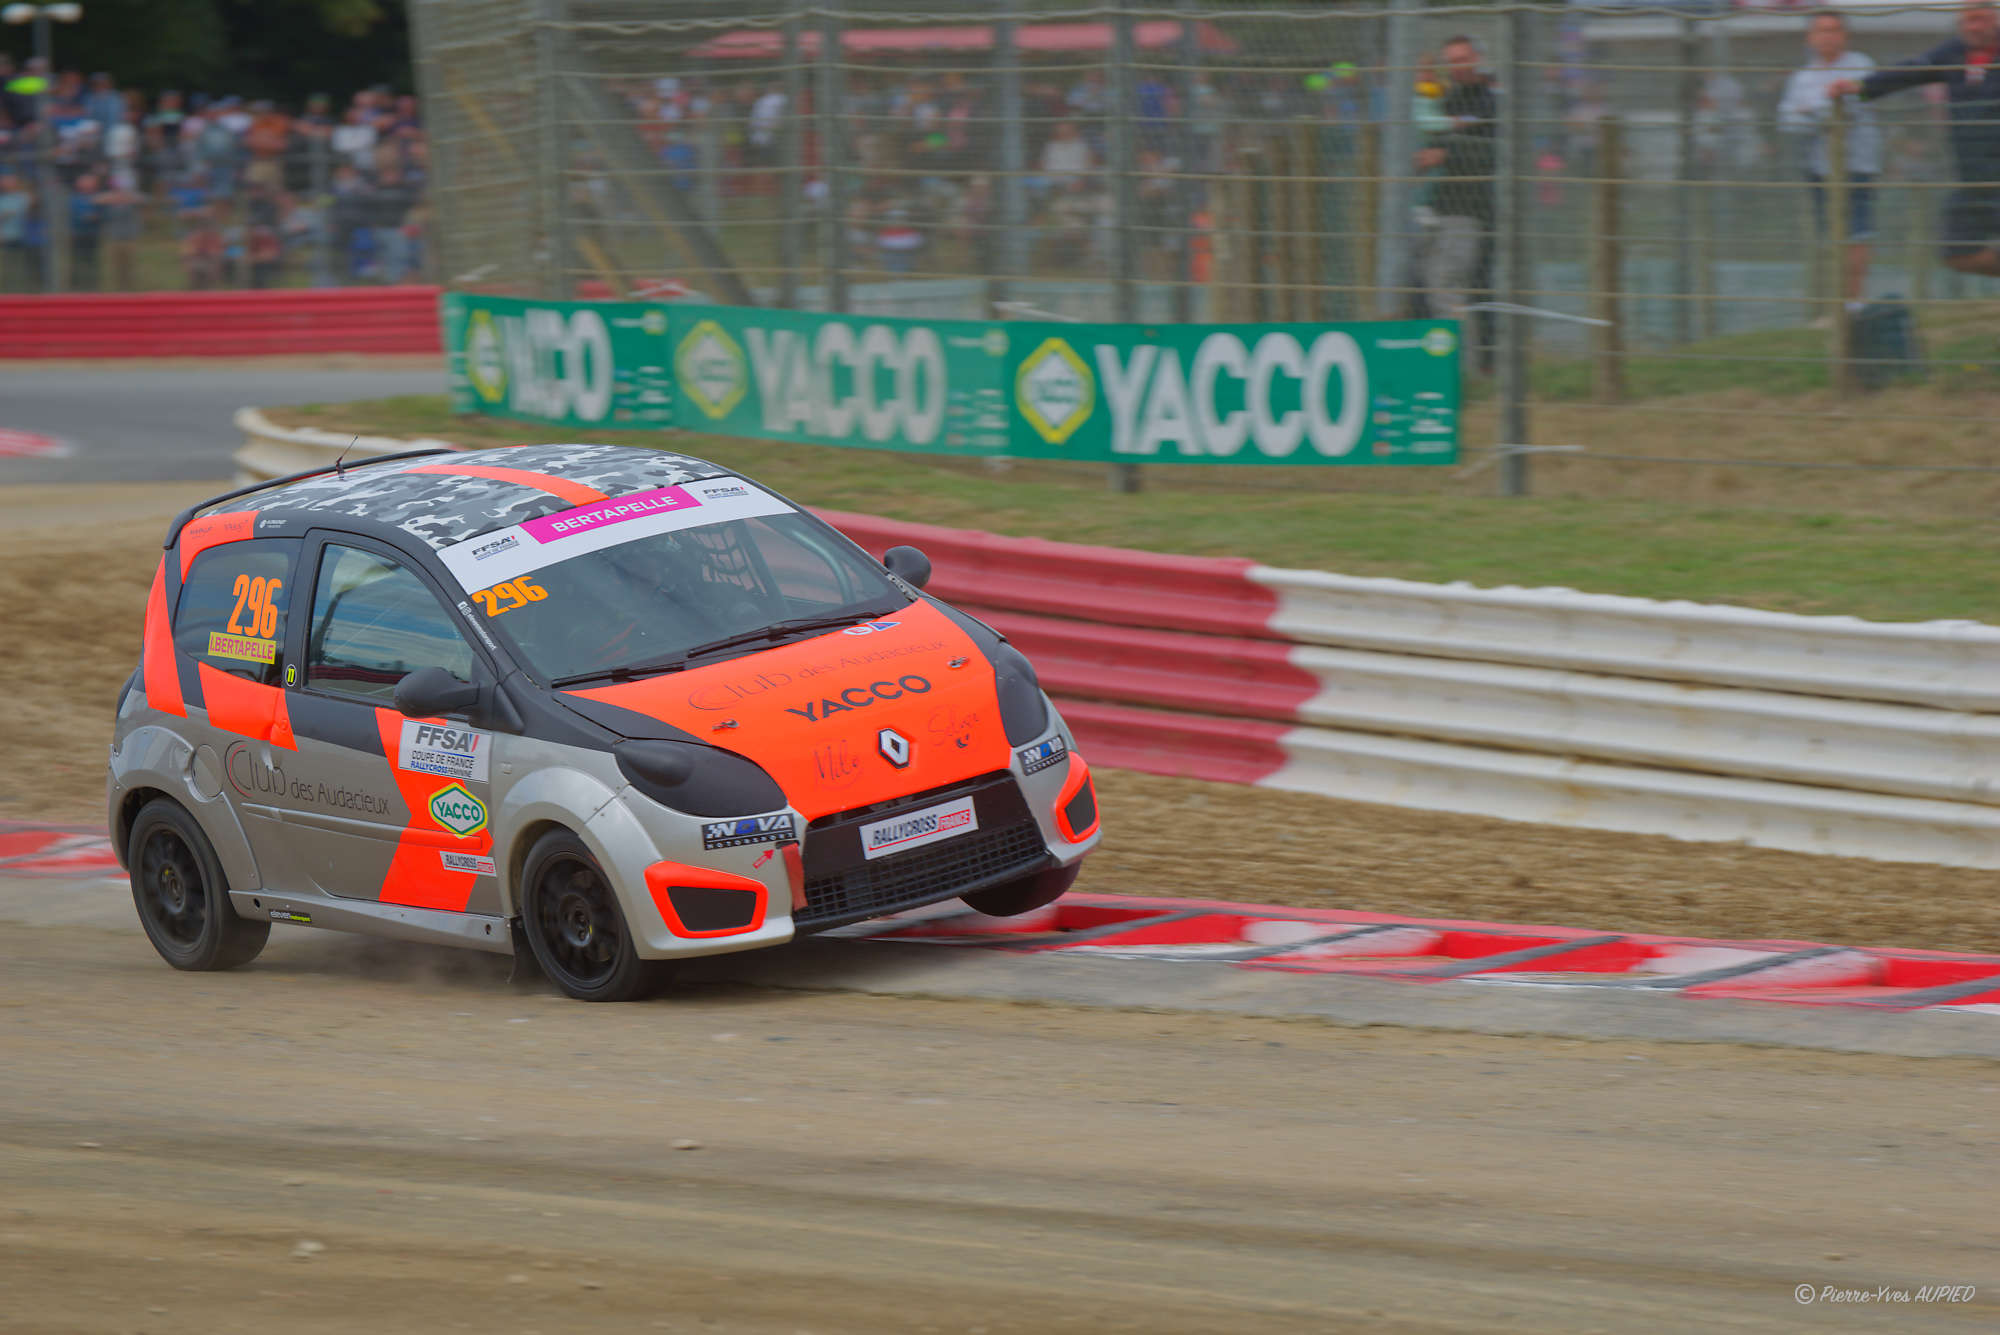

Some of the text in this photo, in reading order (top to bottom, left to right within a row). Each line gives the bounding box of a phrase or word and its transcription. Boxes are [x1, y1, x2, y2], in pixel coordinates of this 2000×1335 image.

[743, 322, 946, 444] YACCO
[1094, 331, 1368, 457] YACCO
[551, 495, 679, 533] BERTAPELLE
[471, 536, 512, 555] FFSA
[226, 573, 283, 639] 296
[471, 575, 549, 617] 296
[209, 636, 275, 660] I.BERTAPELLE
[688, 671, 793, 711] Club
[784, 675, 932, 722] YACCO
[415, 725, 470, 752] FFSA
[224, 739, 392, 816] Club des Audacieux
[411, 750, 475, 770] COUPE DE FRANCE
[435, 800, 480, 822] YACCO
[716, 815, 793, 837] NOVA
[873, 813, 938, 846] RALLYCROSS
